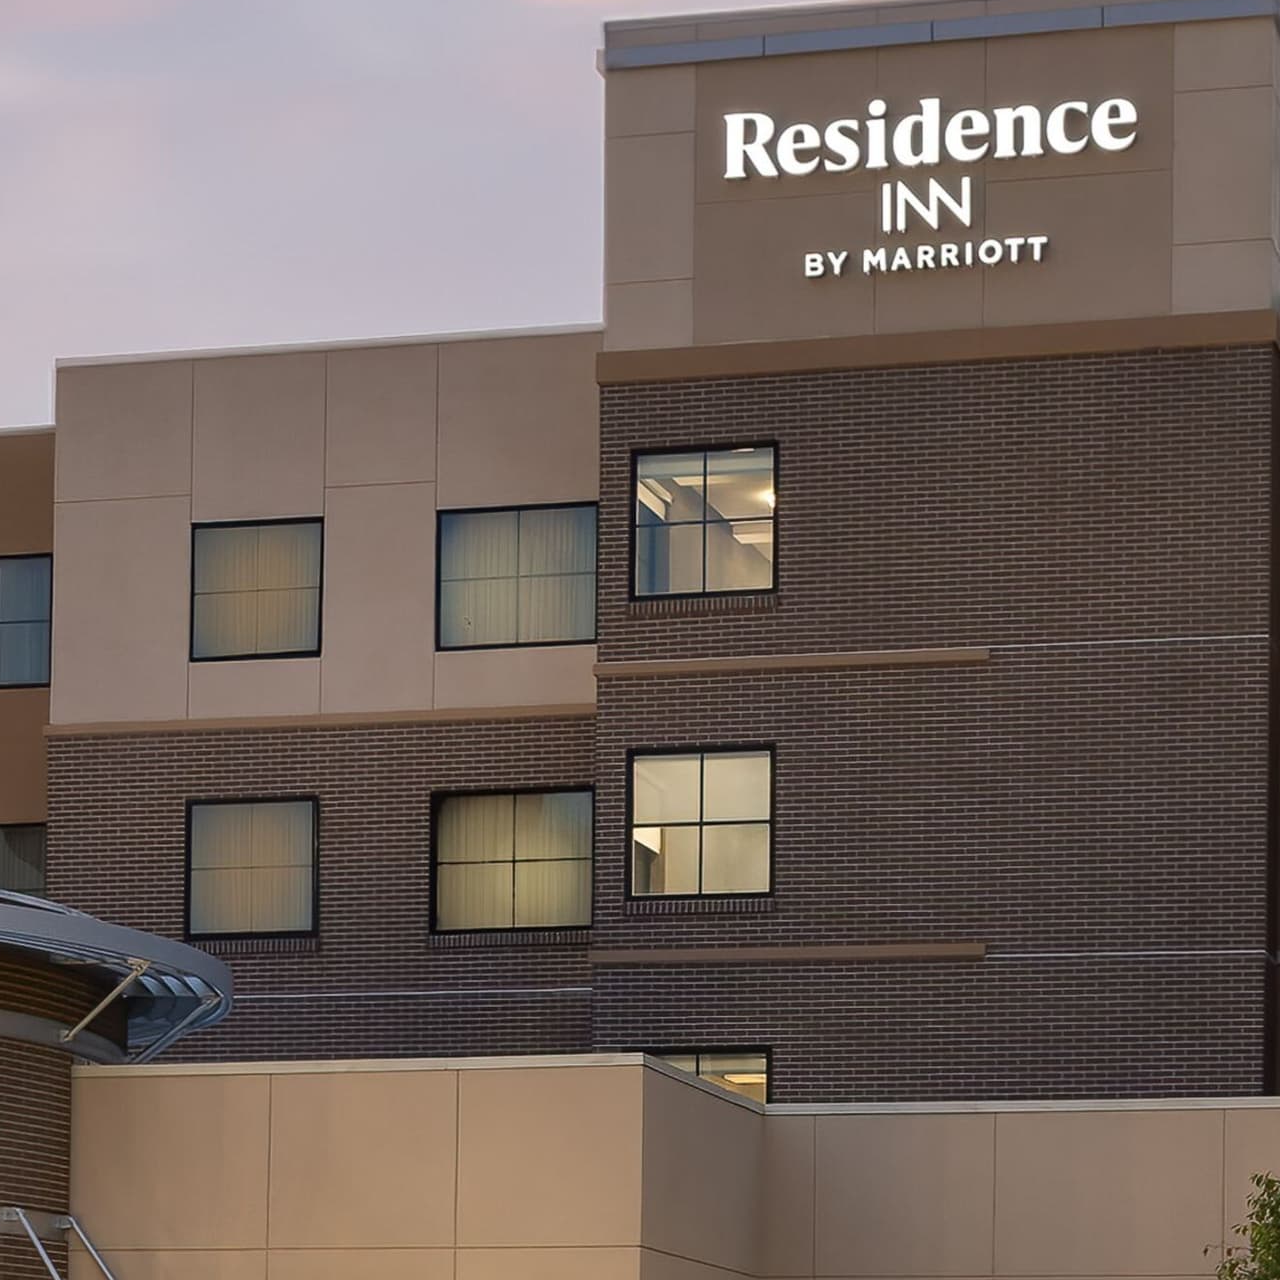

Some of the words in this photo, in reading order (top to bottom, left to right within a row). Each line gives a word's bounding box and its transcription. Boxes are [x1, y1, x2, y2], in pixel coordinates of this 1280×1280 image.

[723, 98, 1138, 179] Residence
[881, 176, 971, 233] INN
[804, 250, 847, 277] BY
[863, 236, 1048, 273] MARRIOTT
